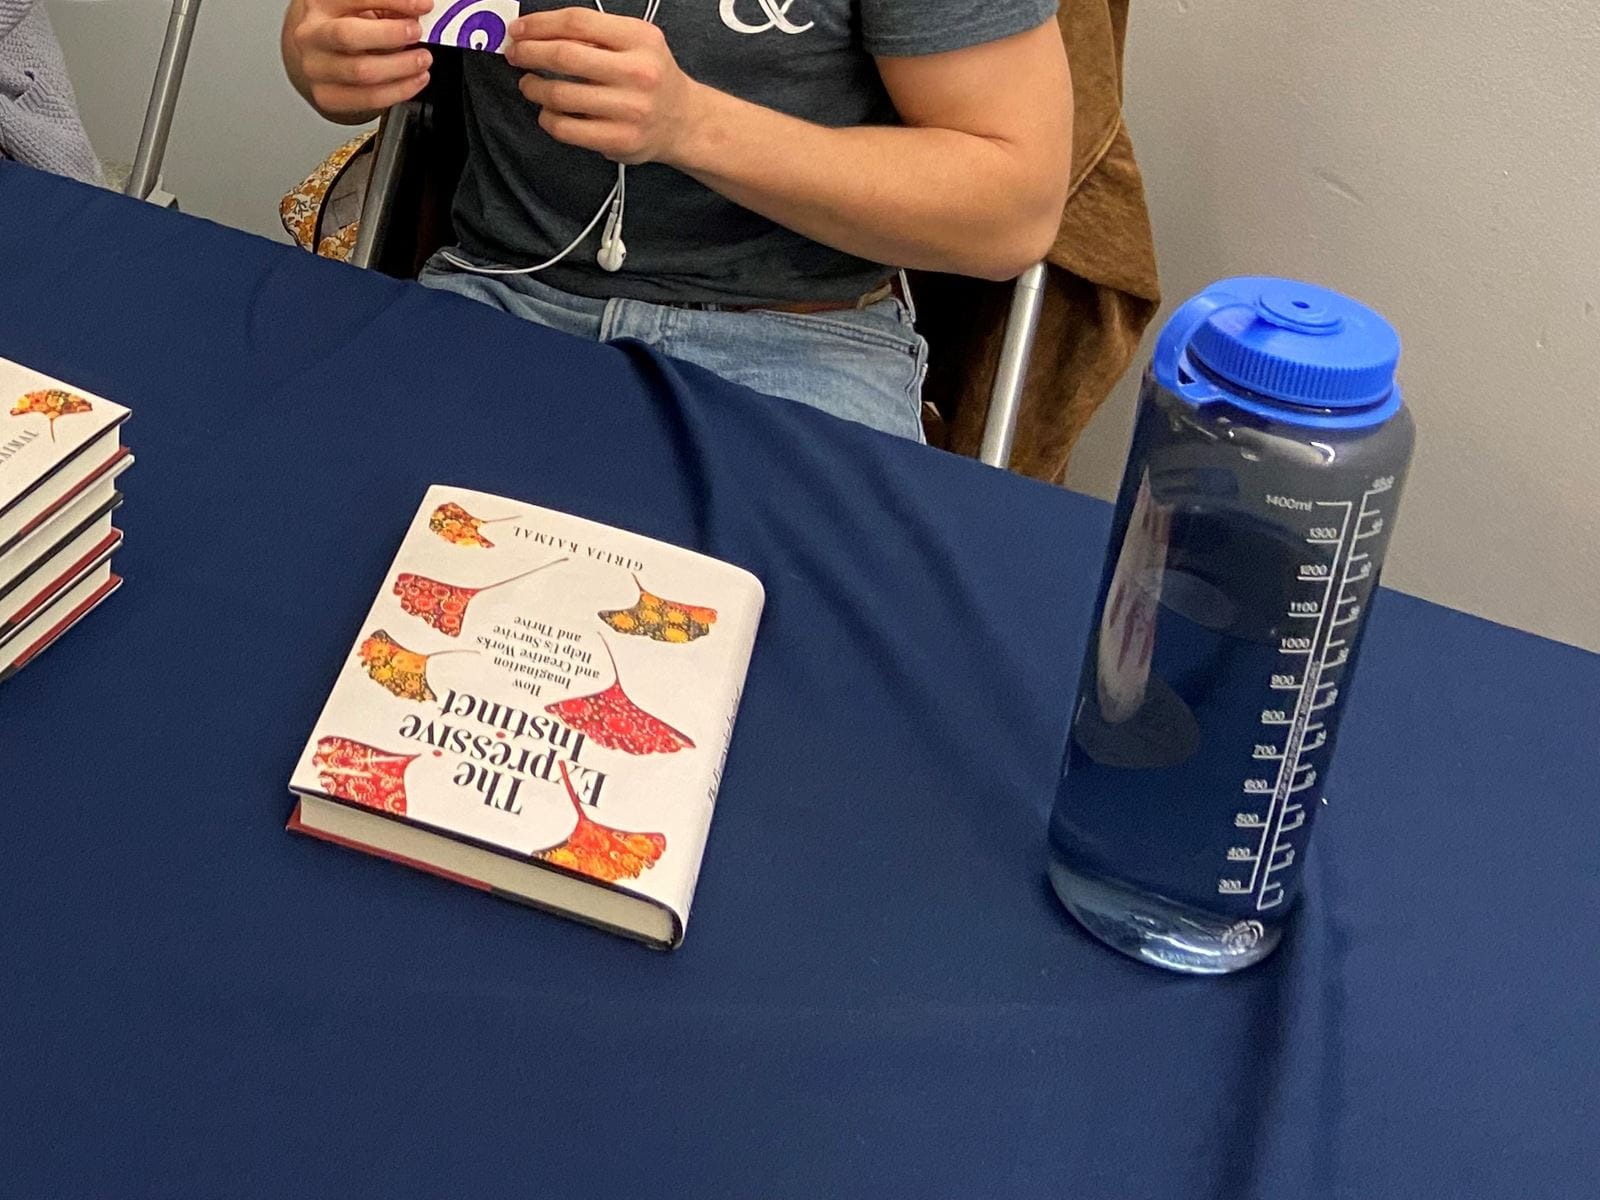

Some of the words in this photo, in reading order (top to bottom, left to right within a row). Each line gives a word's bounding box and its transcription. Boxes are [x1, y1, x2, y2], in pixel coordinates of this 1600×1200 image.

[1265, 494, 1313, 512] 1400ml
[513, 526, 578, 553] KAIMAL
[1309, 527, 1338, 539] 1300
[587, 546, 643, 572] GIRIJA
[1300, 564, 1328, 576] 1200
[1290, 601, 1318, 613] 1100
[514, 616, 554, 637] Thrive
[557, 628, 582, 642] and
[493, 625, 542, 649] Survive
[1281, 638, 1311, 649] 1000
[476, 636, 515, 657] Works
[562, 646, 593, 664] Help
[520, 649, 572, 673] Creative
[493, 656, 572, 689] Imagination
[575, 662, 600, 679] and
[512, 678, 543, 697] How
[1271, 674, 1295, 686] 900
[437, 688, 586, 764] Instinct
[1254, 744, 1277, 755] 700
[399, 714, 609, 809] Expressive
[452, 761, 525, 816] The
[1228, 847, 1250, 858] 400
[1219, 879, 1242, 890] 300
